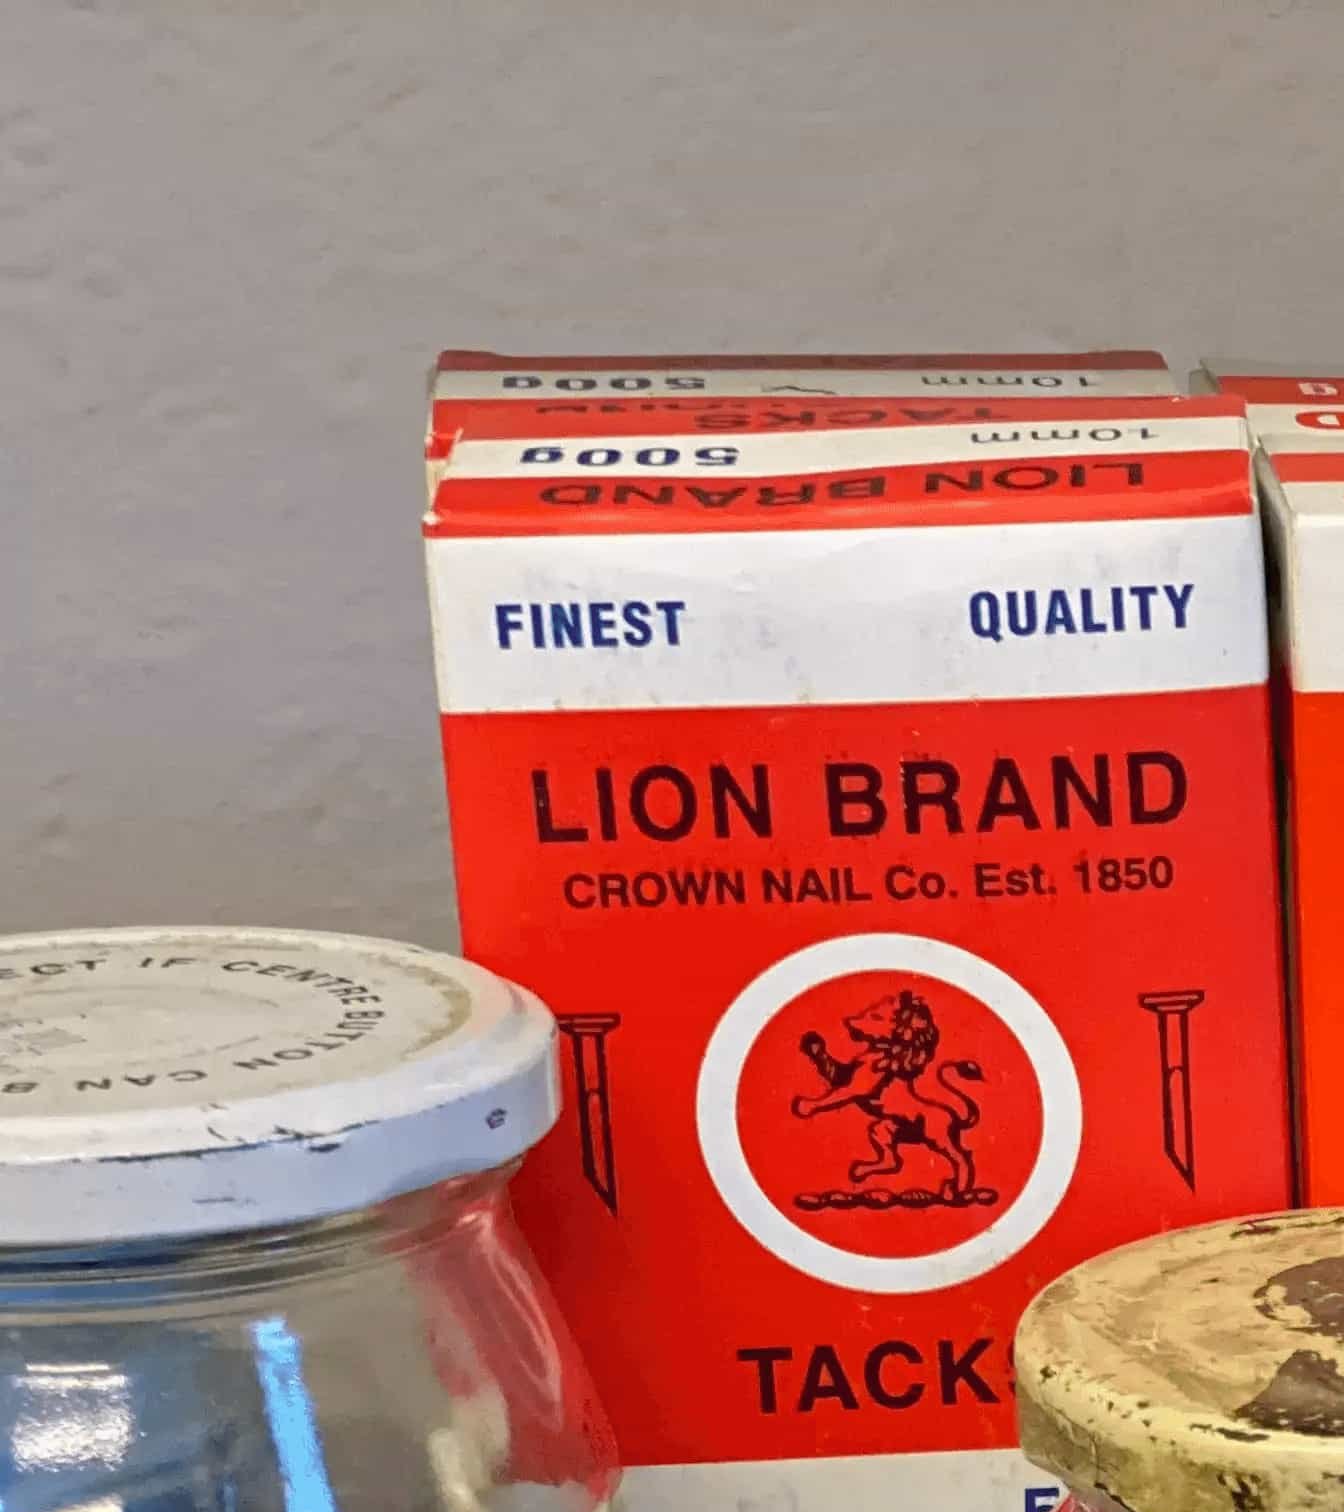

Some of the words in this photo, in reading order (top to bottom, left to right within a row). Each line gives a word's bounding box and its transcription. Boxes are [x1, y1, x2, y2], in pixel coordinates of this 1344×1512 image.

[922, 375, 1100, 388] 10mm
[694, 407, 1009, 430] TACKS
[971, 427, 1161, 445] 10mm
[520, 447, 741, 467] 500g
[540, 474, 886, 508] BRAND
[923, 462, 1145, 495] LION
[494, 599, 687, 650] FINEST
[967, 583, 1196, 642] QUALITY
[531, 762, 774, 844] LION
[824, 750, 1190, 837] BRAND
[562, 867, 747, 911] CROWN
[761, 866, 873, 905] NAIL
[884, 866, 959, 903] Co.
[973, 860, 1057, 898] Est.
[1073, 855, 1176, 895] 1850
[138, 956, 198, 969] IF
[221, 960, 383, 1006] CENTRE
[232, 1009, 386, 1072] BUTTON
[74, 1068, 209, 1093] CAN
[736, 1338, 1018, 1414] TACK
